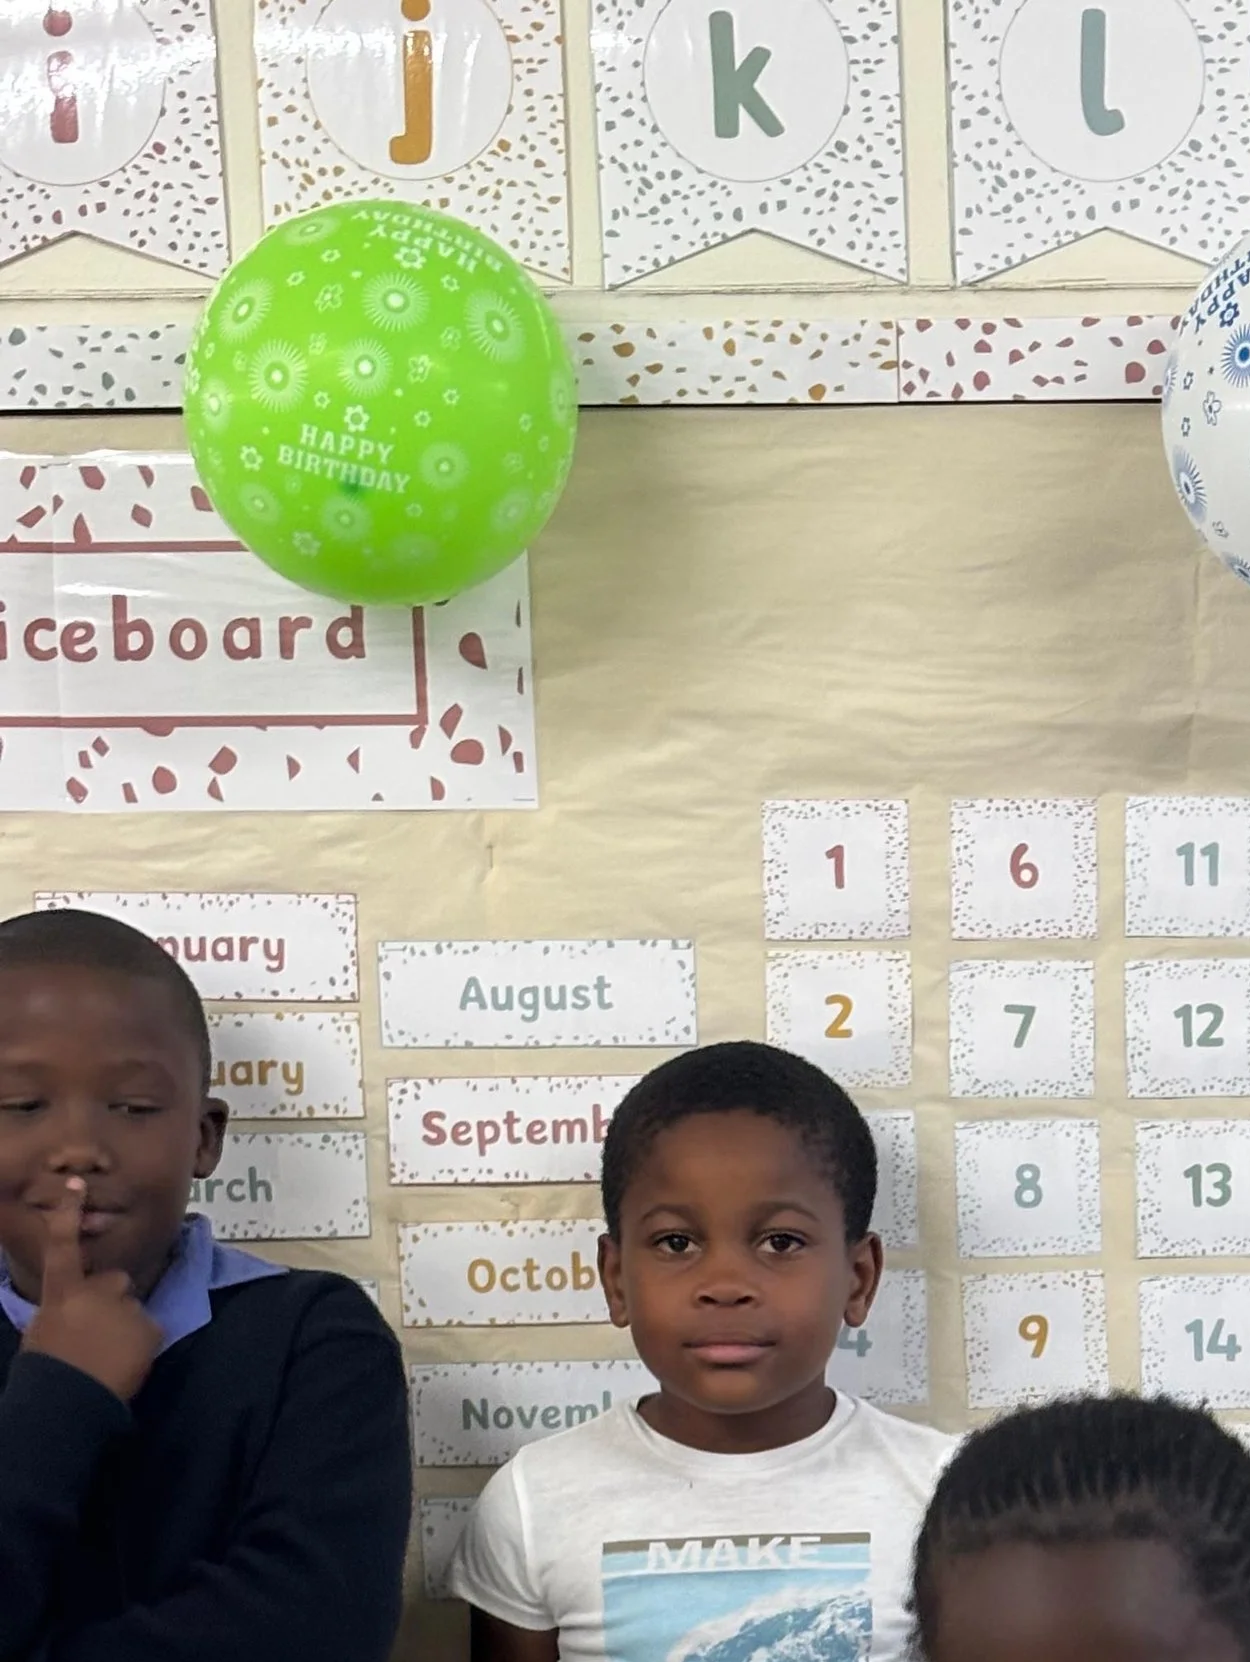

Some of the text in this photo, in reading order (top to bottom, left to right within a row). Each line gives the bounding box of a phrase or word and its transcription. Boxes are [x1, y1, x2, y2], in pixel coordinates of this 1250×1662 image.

[42, 6, 79, 144] i
[388, 0, 433, 165] j
[709, 11, 784, 138] k
[1080, 9, 1124, 136] l
[300, 423, 394, 465] HAPPY
[277, 444, 411, 493] BIRTHDAY
[825, 845, 844, 889] 1
[1010, 843, 1039, 889] 6
[1176, 842, 1219, 886] 11
[460, 976, 613, 1022] August
[825, 994, 853, 1039] 2
[1004, 1005, 1036, 1048] 7
[1174, 1003, 1224, 1047] 12
[1015, 1164, 1042, 1208] 8
[1183, 1163, 1232, 1207] 13
[467, 1251, 596, 1293] Octob
[1018, 1315, 1048, 1358] 9
[1185, 1319, 1241, 1361] 14
[647, 1536, 821, 1571] MAKE
